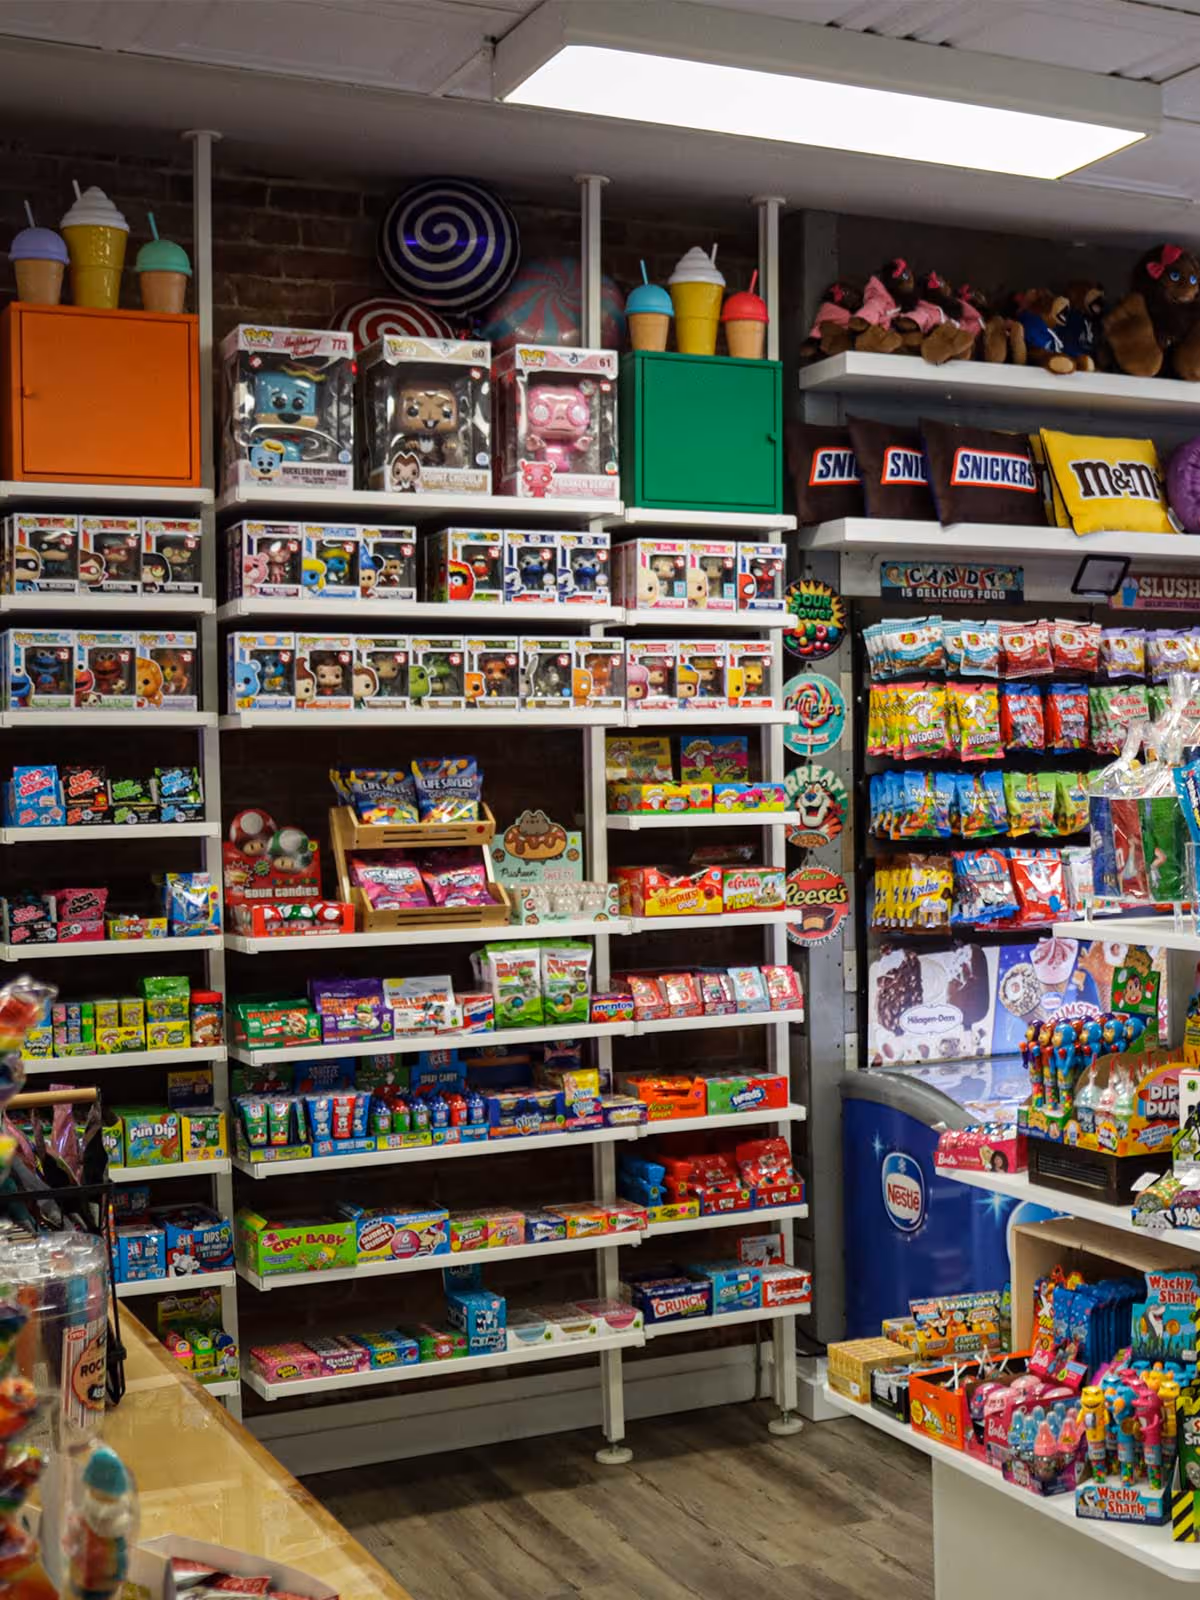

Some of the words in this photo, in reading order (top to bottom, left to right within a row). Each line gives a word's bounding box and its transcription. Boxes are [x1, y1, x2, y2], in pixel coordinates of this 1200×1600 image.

[959, 452, 1034, 488] SNICKERS
[907, 567, 998, 588] CANDY
[793, 592, 832, 608] SOUR
[902, 588, 914, 598] IS
[918, 588, 974, 599] DELICIOUS
[977, 590, 1006, 600] FOOD
[785, 882, 849, 907] Reese's
[593, 1000, 634, 1011] mentos
[1151, 1085, 1180, 1101] DIP
[129, 1126, 153, 1141] Fun
[154, 1123, 177, 1138] Dip
[271, 1234, 303, 1254] CRY
[305, 1233, 348, 1246] BABY
[401, 1233, 411, 1244] 6
[1149, 1276, 1193, 1293] Wacky
[655, 1295, 705, 1316] CRUNCH
[1097, 1487, 1140, 1502] Wacky
[1107, 1500, 1147, 1515] Shark
